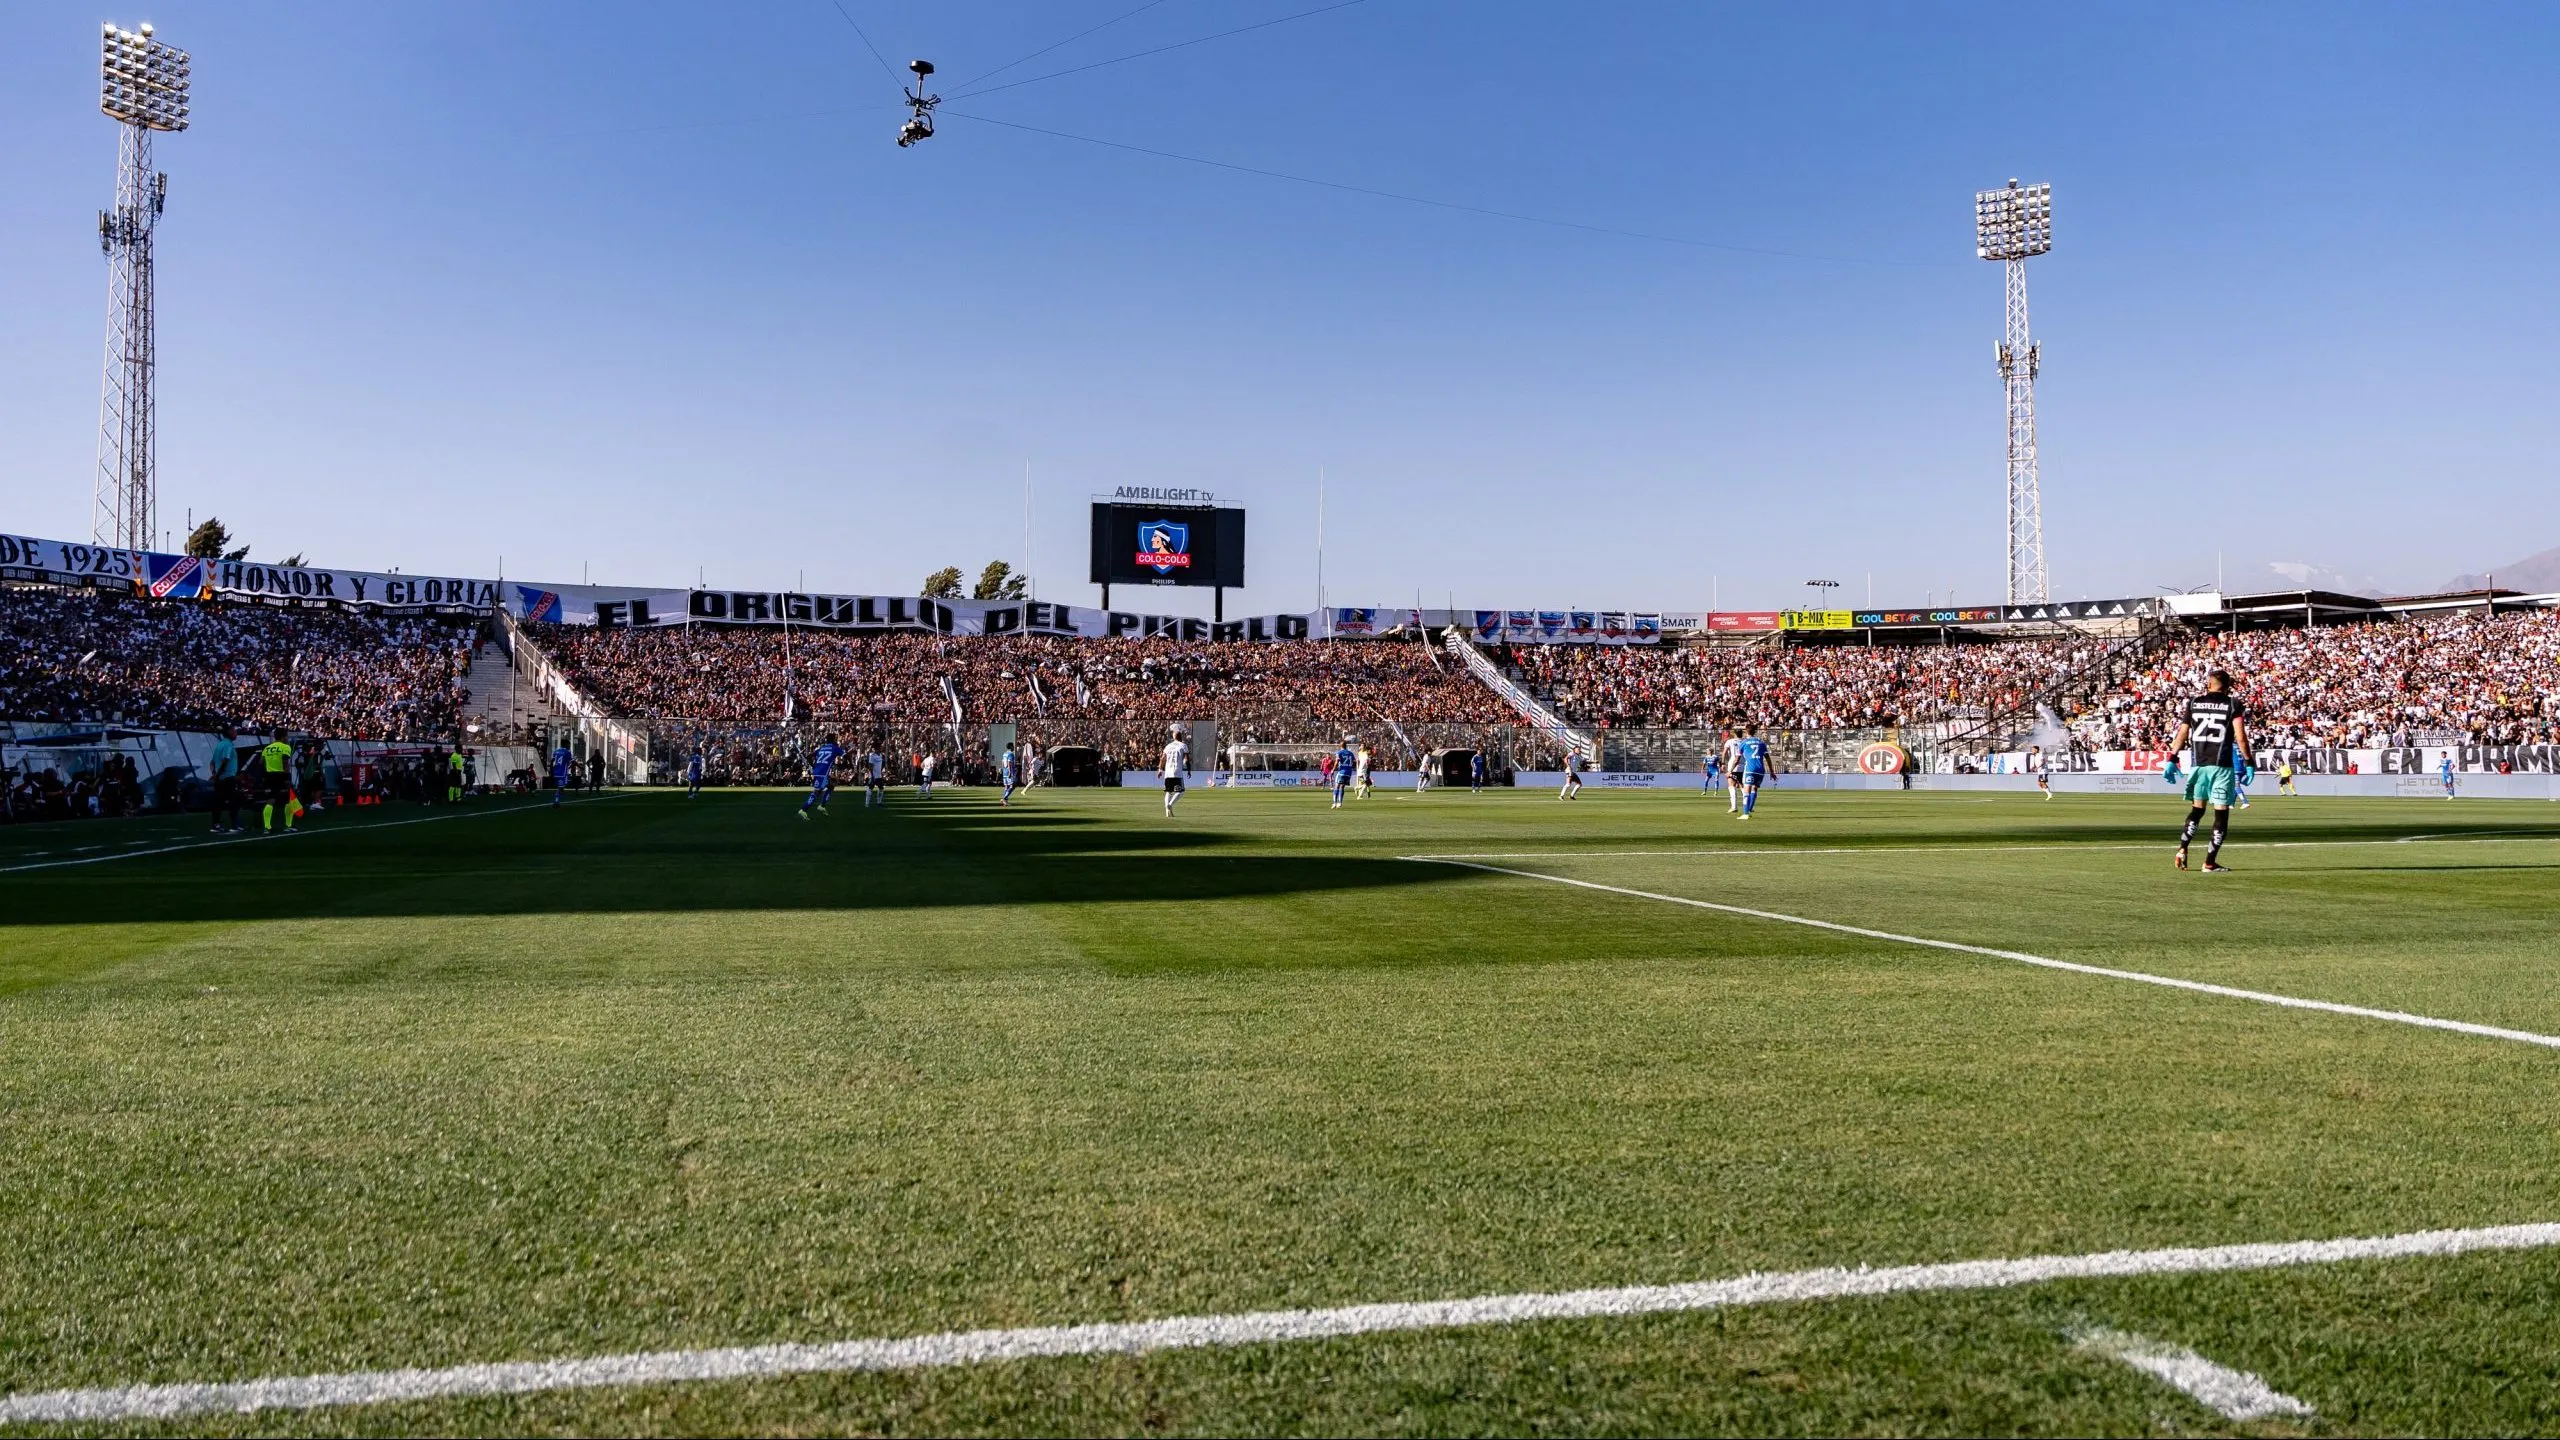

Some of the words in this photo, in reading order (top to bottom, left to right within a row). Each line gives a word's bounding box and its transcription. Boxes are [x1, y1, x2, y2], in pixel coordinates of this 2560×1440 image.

[1114, 485, 1198, 501] AMBILIGHT
[1200, 490, 1215, 502] tv
[60, 544, 131, 576] 1925
[1138, 554, 1188, 564] COLO-COLO
[155, 555, 199, 595] COLO-COLO
[222, 562, 335, 597] HONOR
[350, 577, 368, 602] Y
[386, 579, 494, 606] GLORIA
[594, 599, 660, 627] EL
[687, 589, 954, 633] ORGULLO
[984, 601, 1079, 635] DEL
[1108, 612, 1310, 643] PUEBLO
[1798, 611, 1824, 623] B-MIX
[1856, 613, 1906, 624] COOLBET
[1929, 611, 1981, 622] COOLBET
[1662, 618, 1698, 628] SMART
[2192, 712, 2227, 743] 25
[266, 746, 281, 754] TCL
[1750, 744, 1761, 759] 2
[816, 751, 832, 764] 22
[1869, 750, 1894, 772] PF
[2123, 749, 2181, 772] 192
[2380, 748, 2423, 775] EN
[1273, 778, 1323, 787] COOLBET
[1602, 774, 1655, 782] JETOUR
[2099, 777, 2145, 785] JETOUR
[2397, 777, 2463, 787] JETOR
